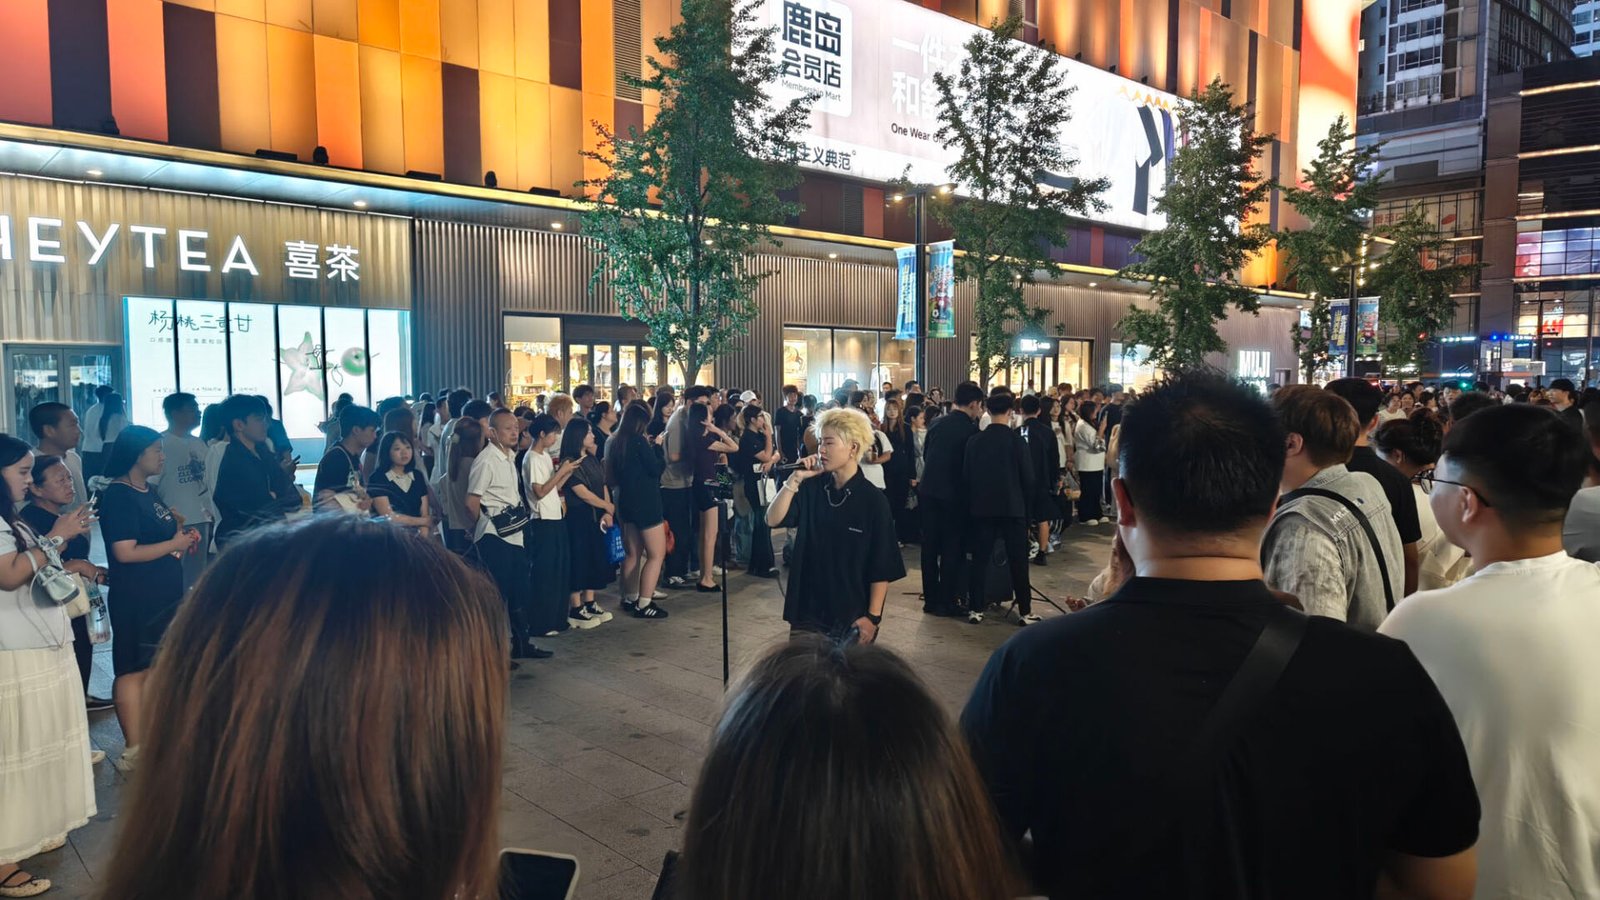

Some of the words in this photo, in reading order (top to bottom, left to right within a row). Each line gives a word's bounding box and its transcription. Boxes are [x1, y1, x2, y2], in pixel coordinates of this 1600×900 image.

[782, 0, 841, 57] 鹿岛
[782, 47, 842, 89] 会员店
[781, 79, 824, 99] Membership
[825, 90, 842, 102] Mart
[890, 122, 908, 136] One
[909, 126, 930, 141] Wear
[284, 240, 360, 282] 喜茶
